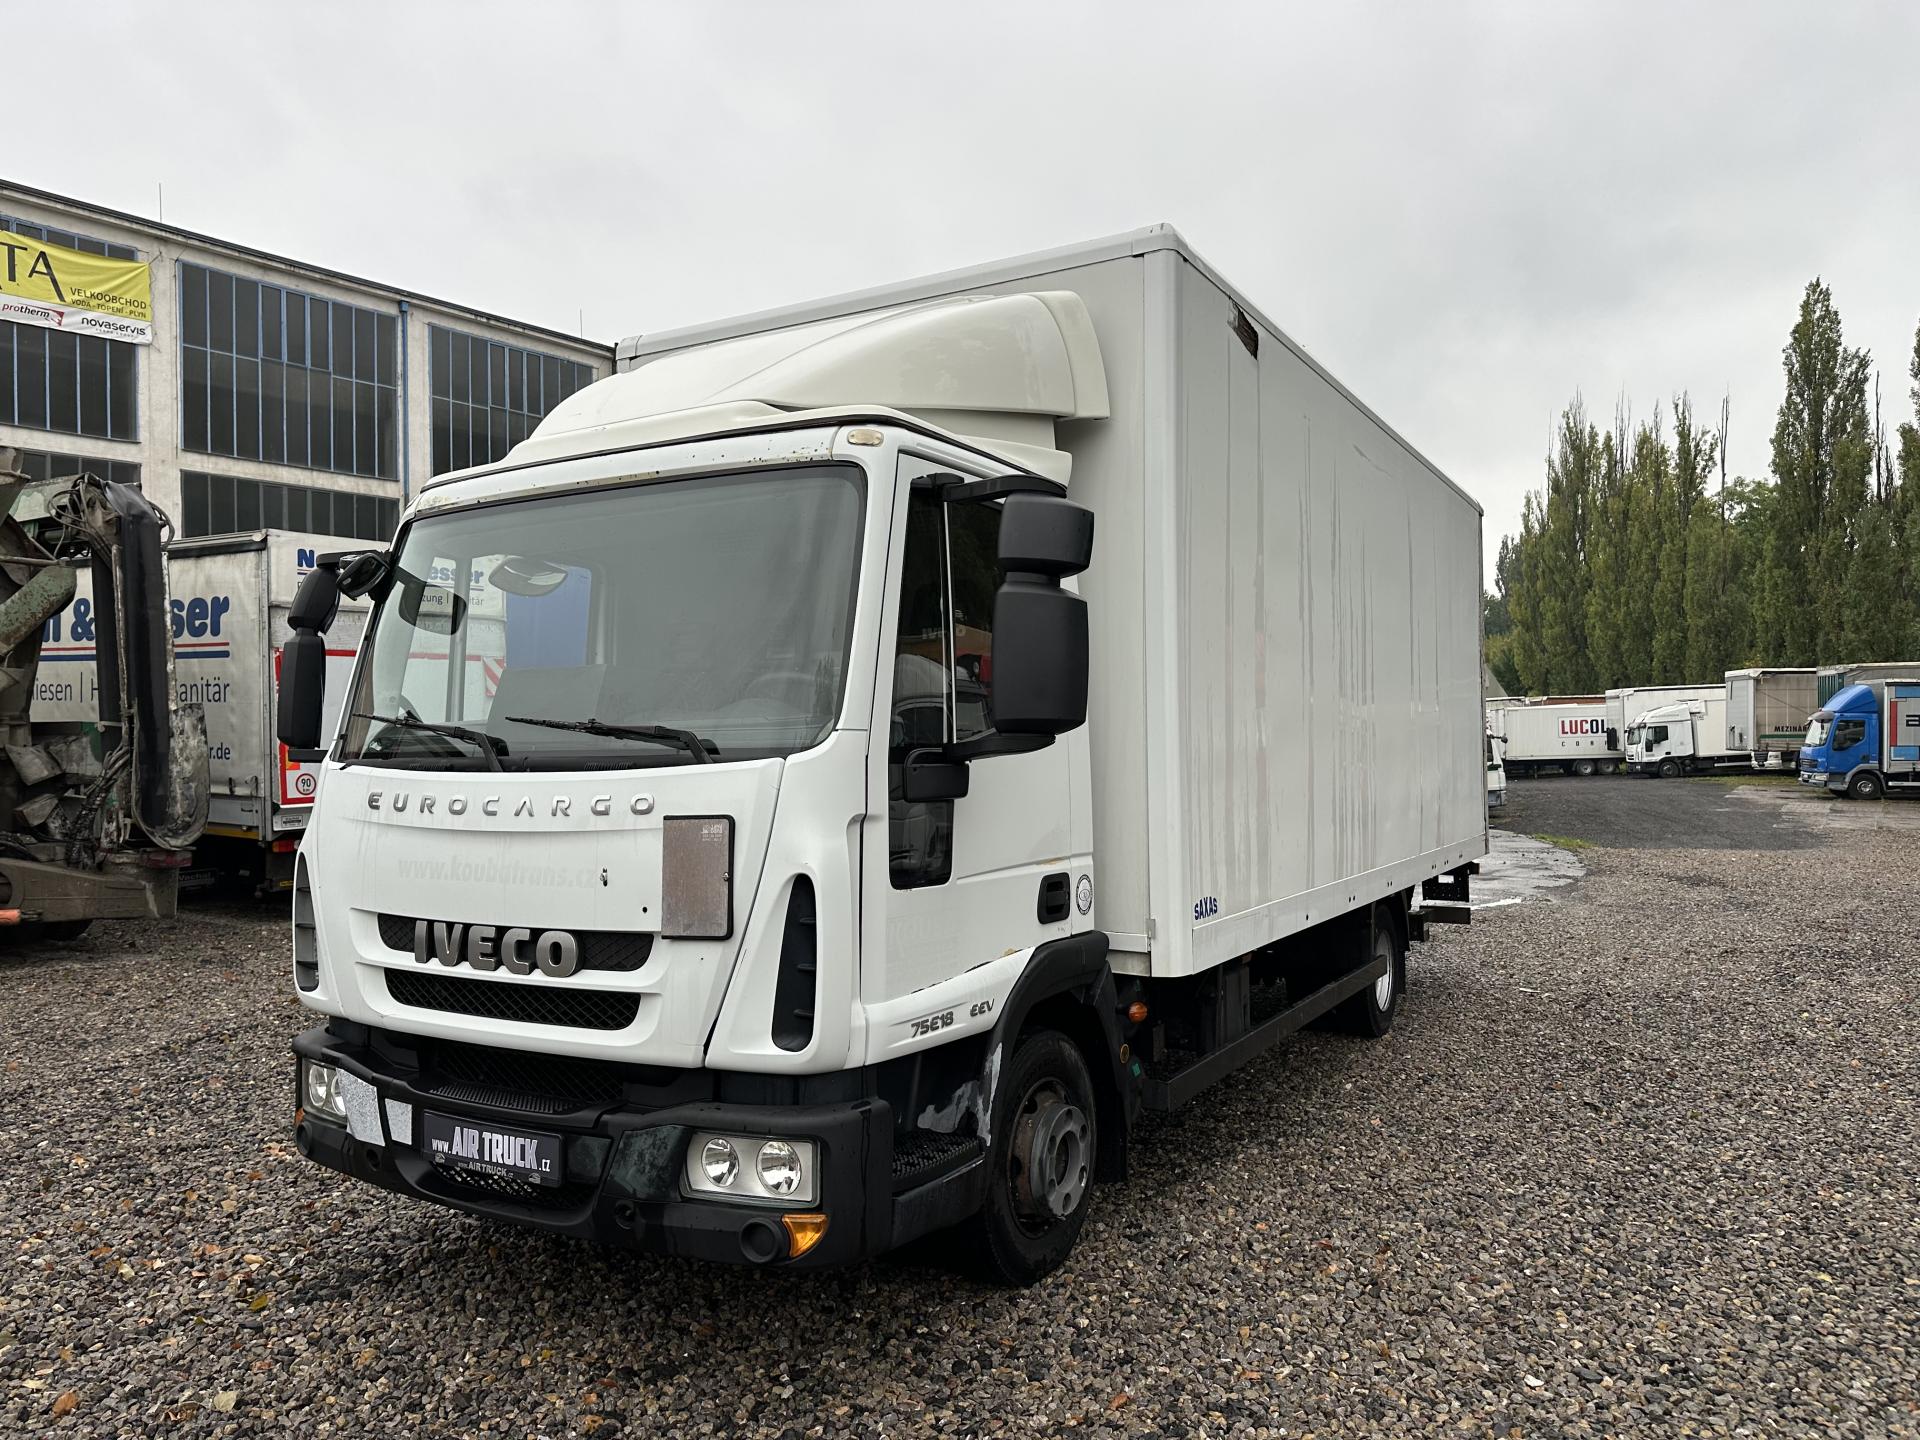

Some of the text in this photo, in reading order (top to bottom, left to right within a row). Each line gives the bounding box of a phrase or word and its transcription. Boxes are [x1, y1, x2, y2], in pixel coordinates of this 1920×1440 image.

[70, 287, 147, 310] VELKOOBCHOD
[71, 298, 91, 308] VODA
[2, 303, 50, 318] protherm
[81, 317, 146, 336] novaservis
[33, 679, 72, 701] iesen
[176, 677, 230, 703] anitär
[301, 778, 311, 788] 90
[367, 791, 655, 818] EUROCARGO
[1194, 896, 1218, 921] SAXAS
[414, 919, 582, 978] IVECO
[911, 998, 995, 1039] 75E18 EEV
